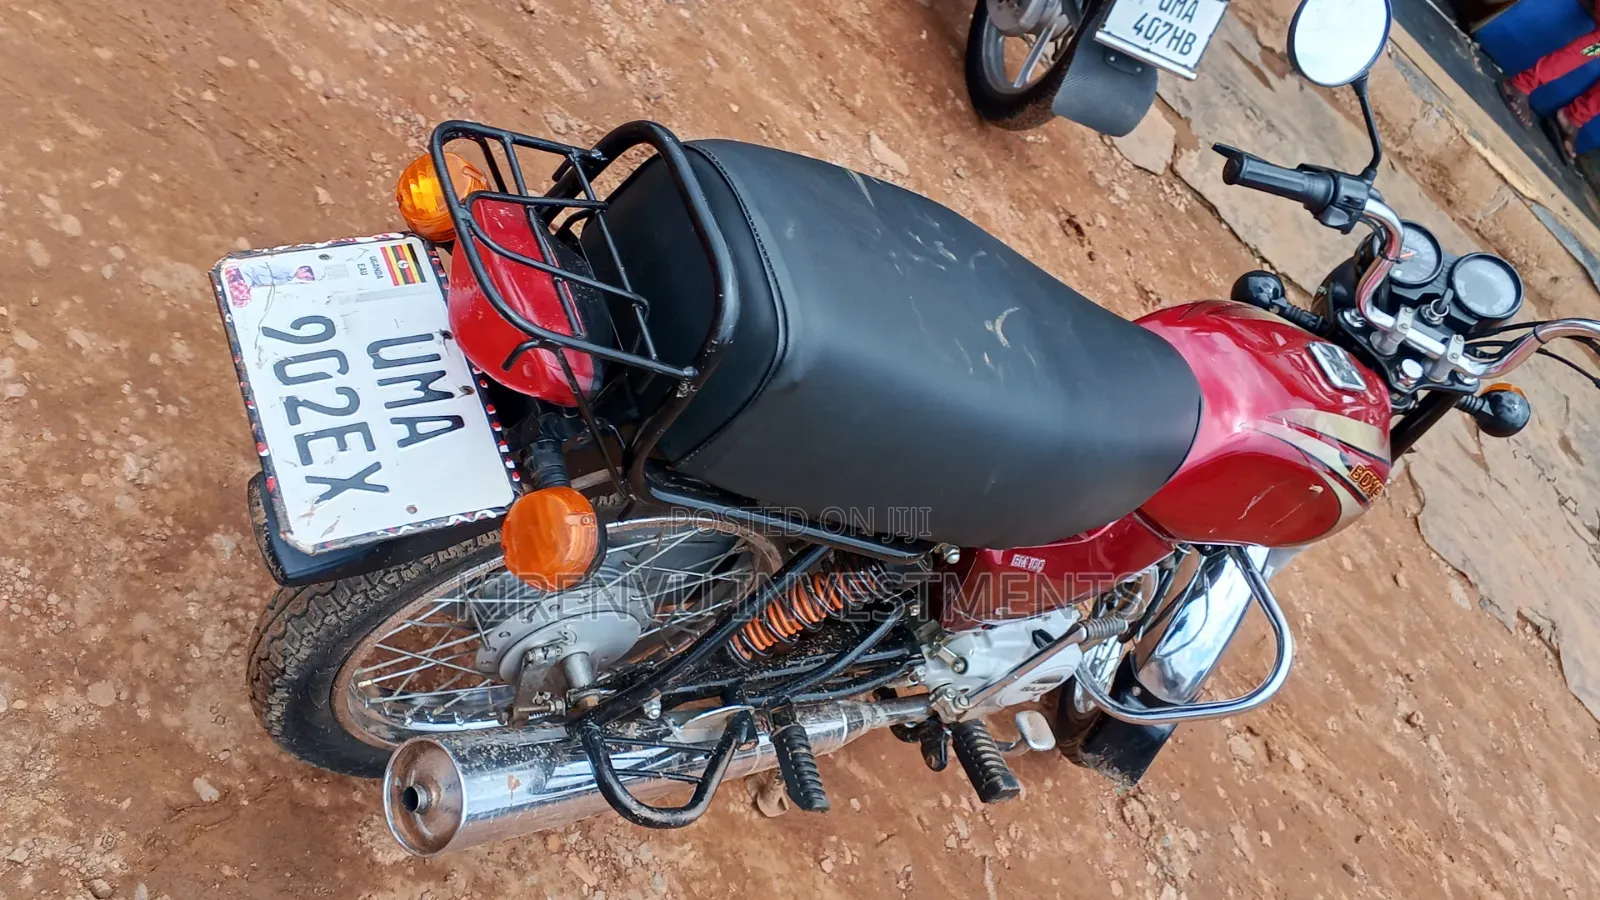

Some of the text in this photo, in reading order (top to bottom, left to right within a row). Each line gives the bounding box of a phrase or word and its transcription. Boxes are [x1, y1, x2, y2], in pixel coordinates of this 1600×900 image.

[1131, 12, 1197, 56] 407HB
[356, 262, 368, 277] EAU
[368, 255, 385, 280] UGANDA
[261, 314, 390, 505] 902EX
[366, 332, 466, 449] UMA
